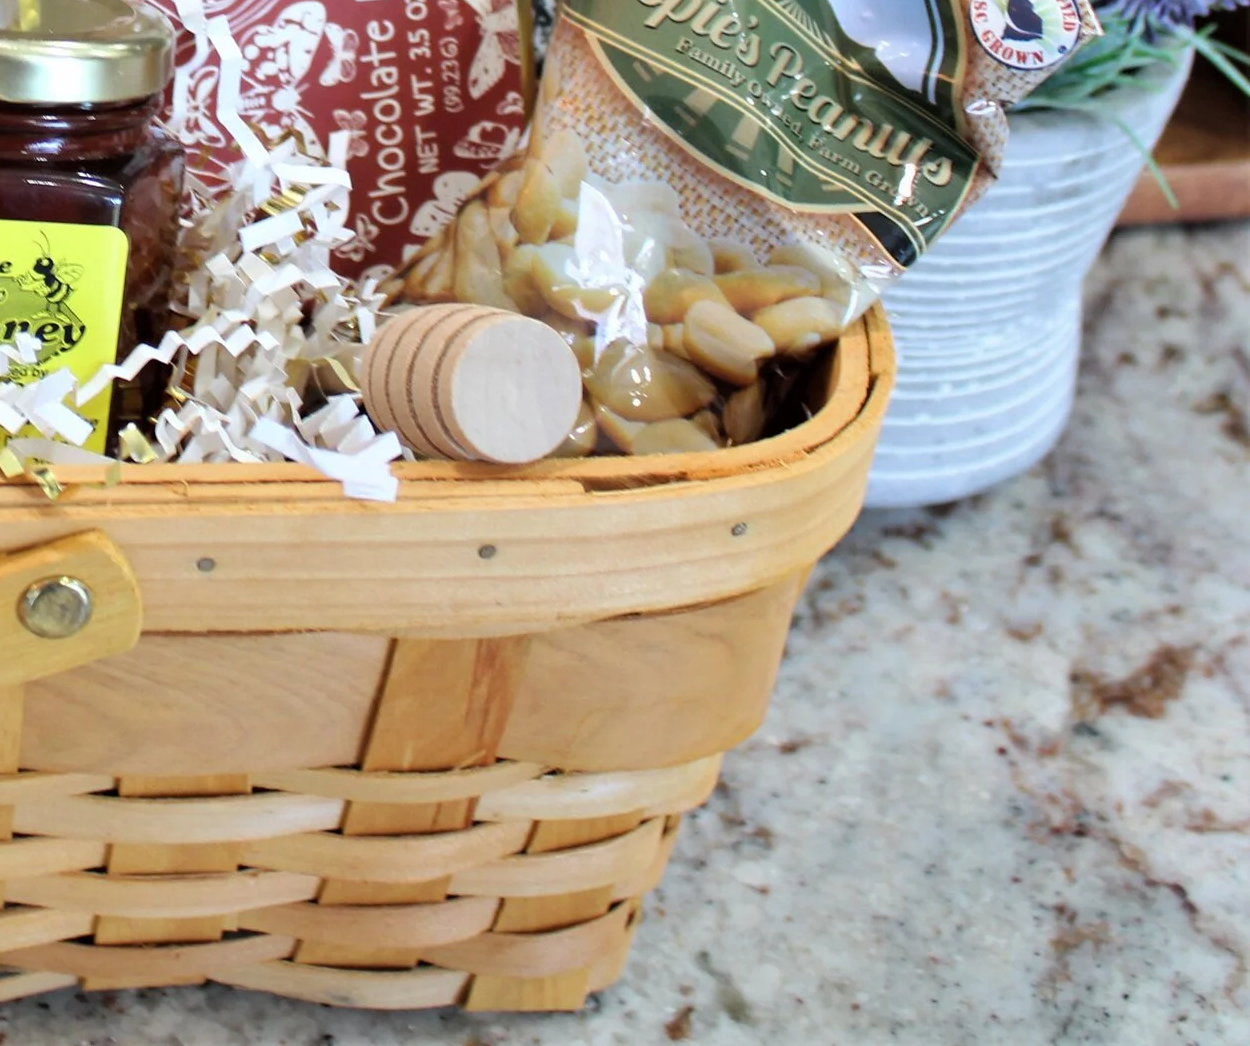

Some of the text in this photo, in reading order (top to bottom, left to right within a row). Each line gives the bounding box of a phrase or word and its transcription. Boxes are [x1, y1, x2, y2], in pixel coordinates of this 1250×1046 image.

[407, 27, 432, 63] 3.5
[972, 0, 1045, 66] SC GROWN
[359, 18, 410, 227] Chocolate
[414, 124, 441, 175] NET
[674, 36, 747, 88] Family
[808, 132, 862, 177] Farm
[766, 40, 954, 187] Peanuts
